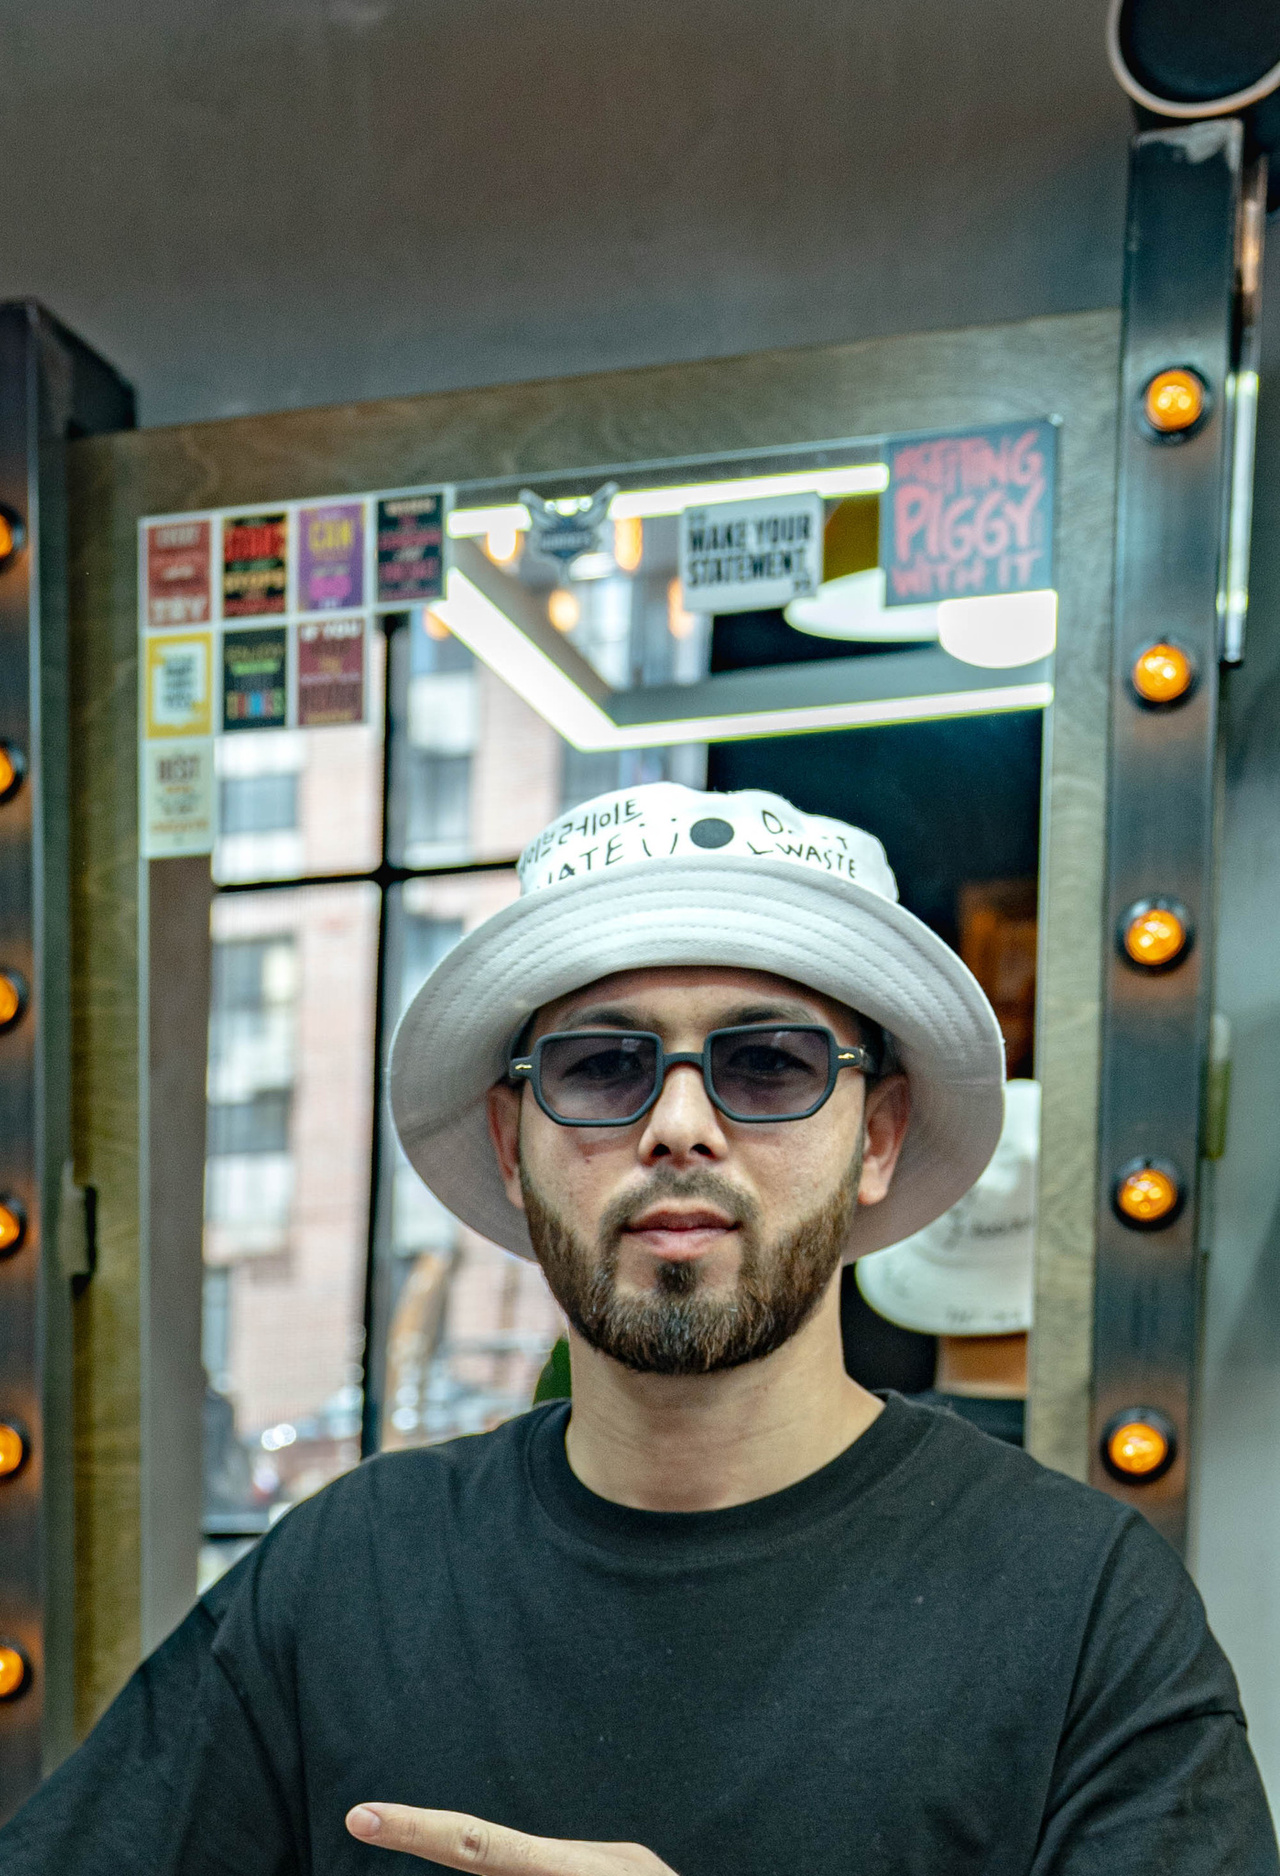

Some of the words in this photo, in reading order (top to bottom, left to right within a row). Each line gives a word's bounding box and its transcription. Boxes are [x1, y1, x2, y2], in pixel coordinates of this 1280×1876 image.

[753, 513, 811, 543] YOUR
[894, 480, 1046, 561] PIGGY
[997, 550, 1044, 589] IT
